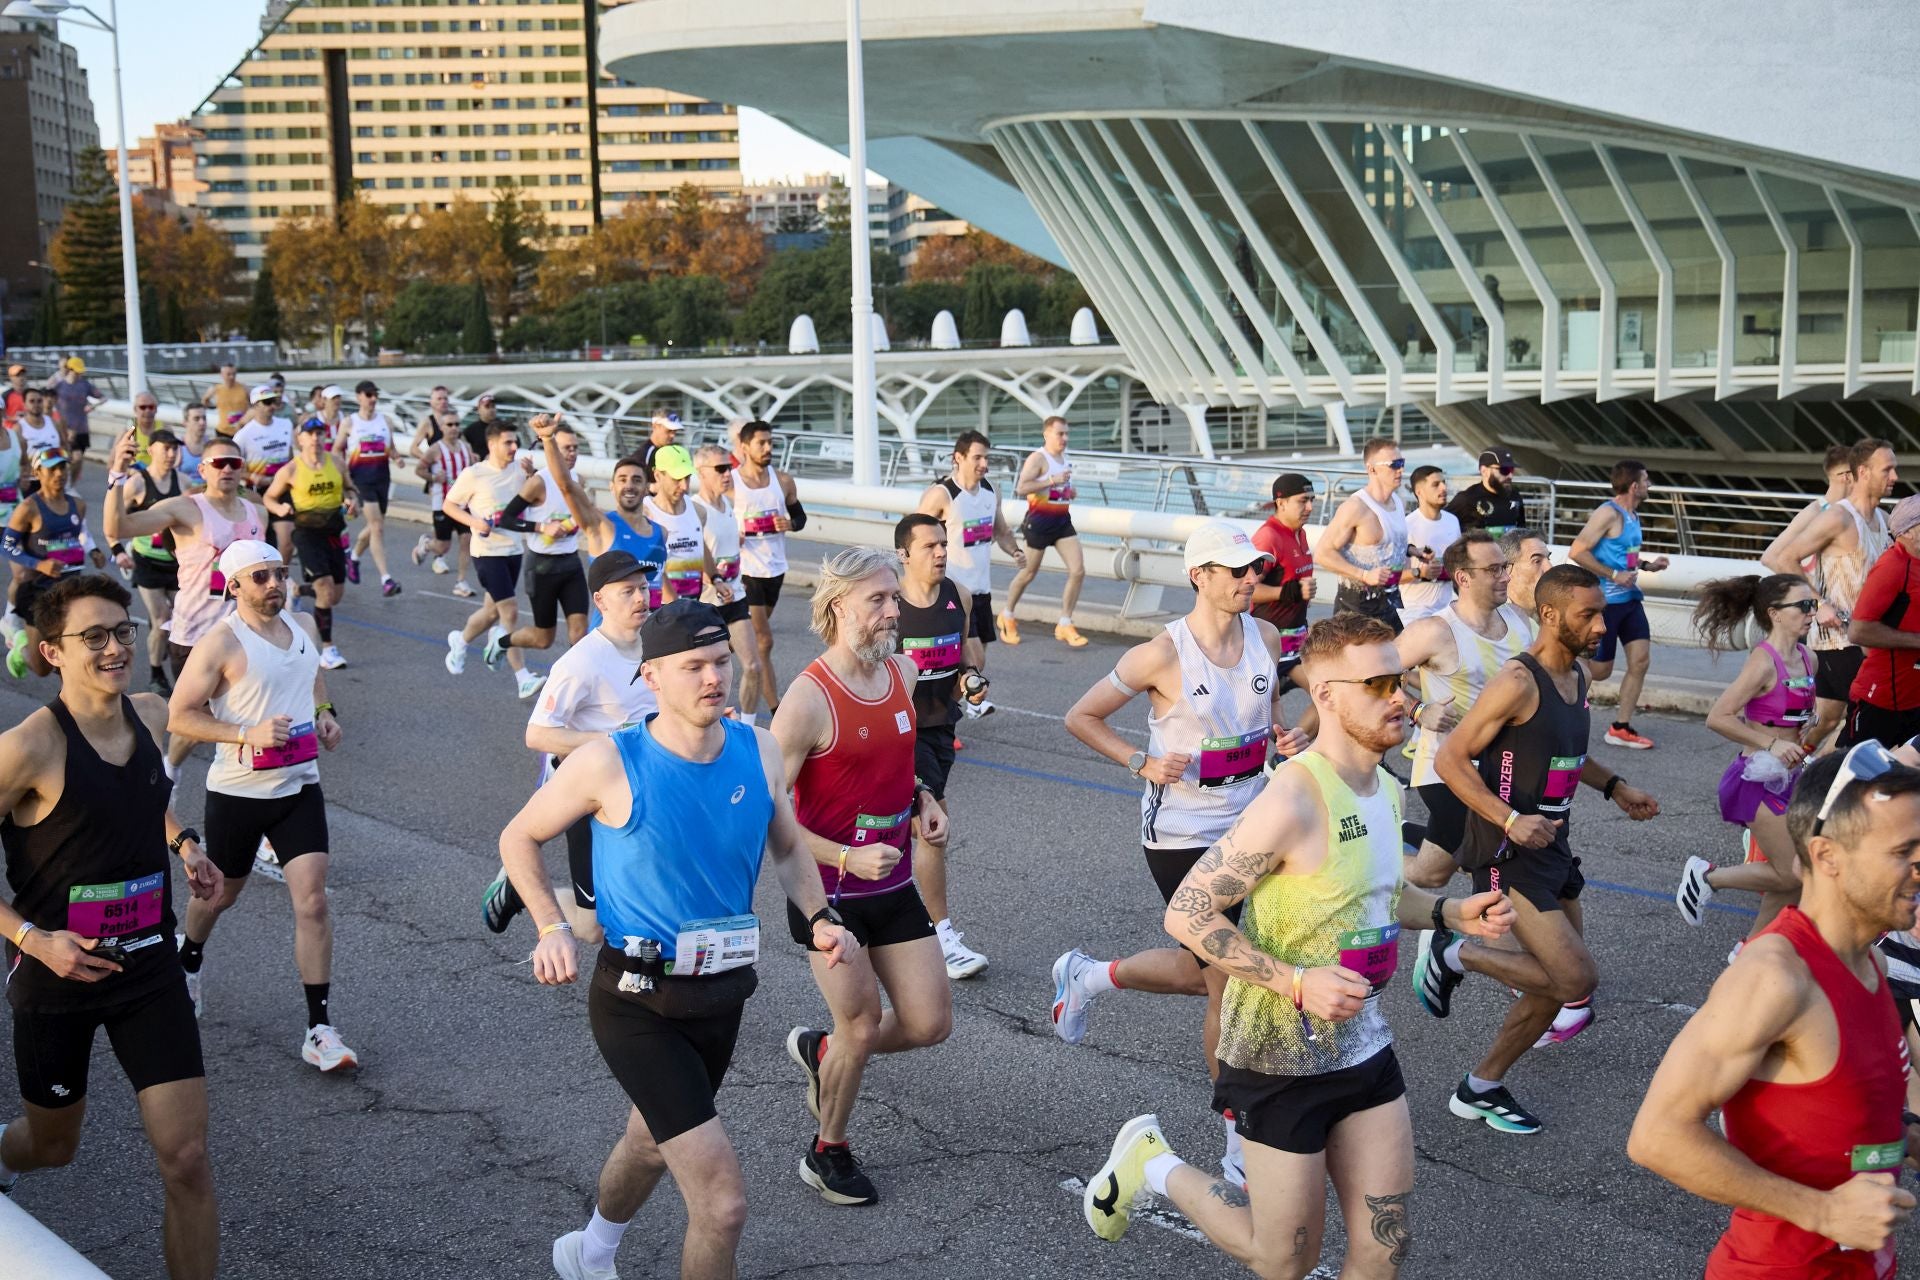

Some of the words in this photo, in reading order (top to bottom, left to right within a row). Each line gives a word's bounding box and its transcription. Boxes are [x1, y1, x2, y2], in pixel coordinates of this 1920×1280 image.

[1226, 748, 1251, 763] 5919
[1340, 814, 1360, 830] ATE
[1339, 824, 1368, 844] MILES
[104, 900, 138, 919] 6514
[100, 918, 139, 935] Patrick
[1368, 948, 1390, 967] 5532
